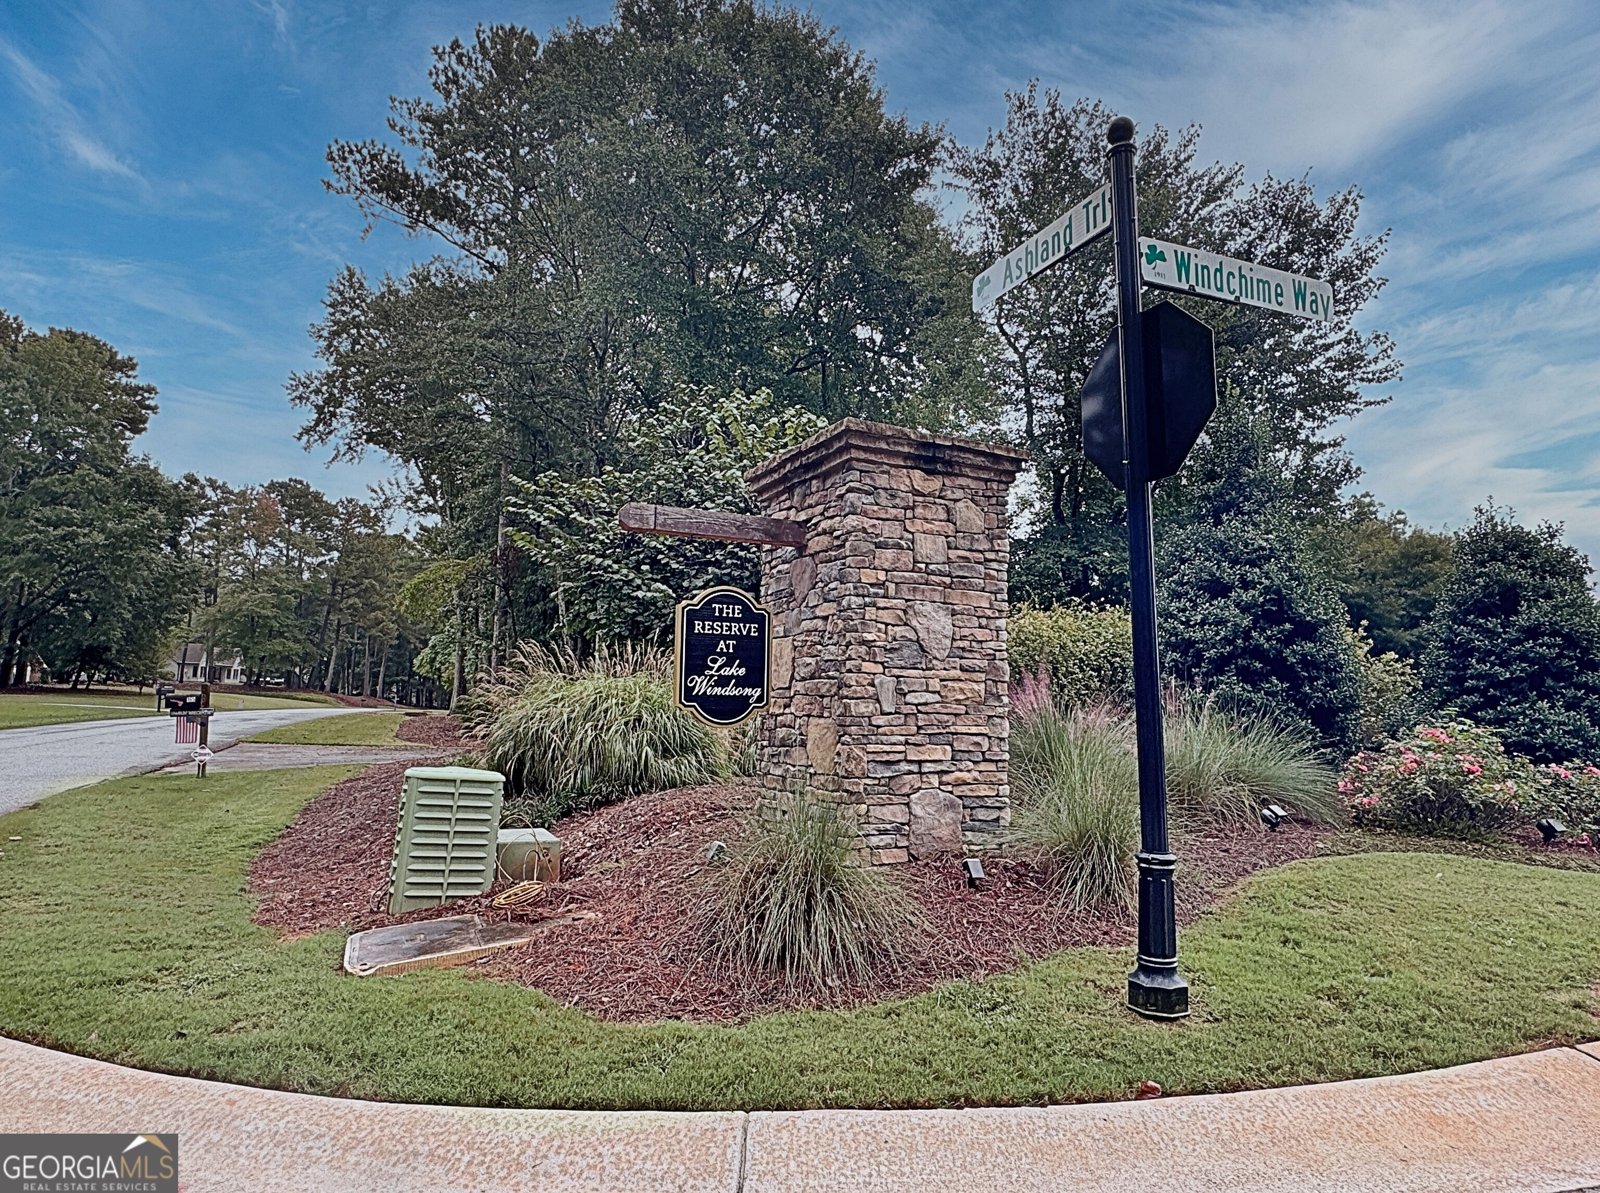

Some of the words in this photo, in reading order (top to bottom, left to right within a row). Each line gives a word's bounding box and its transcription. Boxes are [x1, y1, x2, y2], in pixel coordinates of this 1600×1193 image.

[1002, 214, 1073, 290] Ashland
[1082, 190, 1106, 234] Trl
[1173, 248, 1284, 307] Windchime
[1292, 277, 1331, 320] Way
[712, 603, 742, 617] THE
[694, 620, 758, 636] RESERVE
[716, 640, 736, 653] AT
[704, 655, 746, 676] Lake
[687, 675, 762, 703] Windsong
